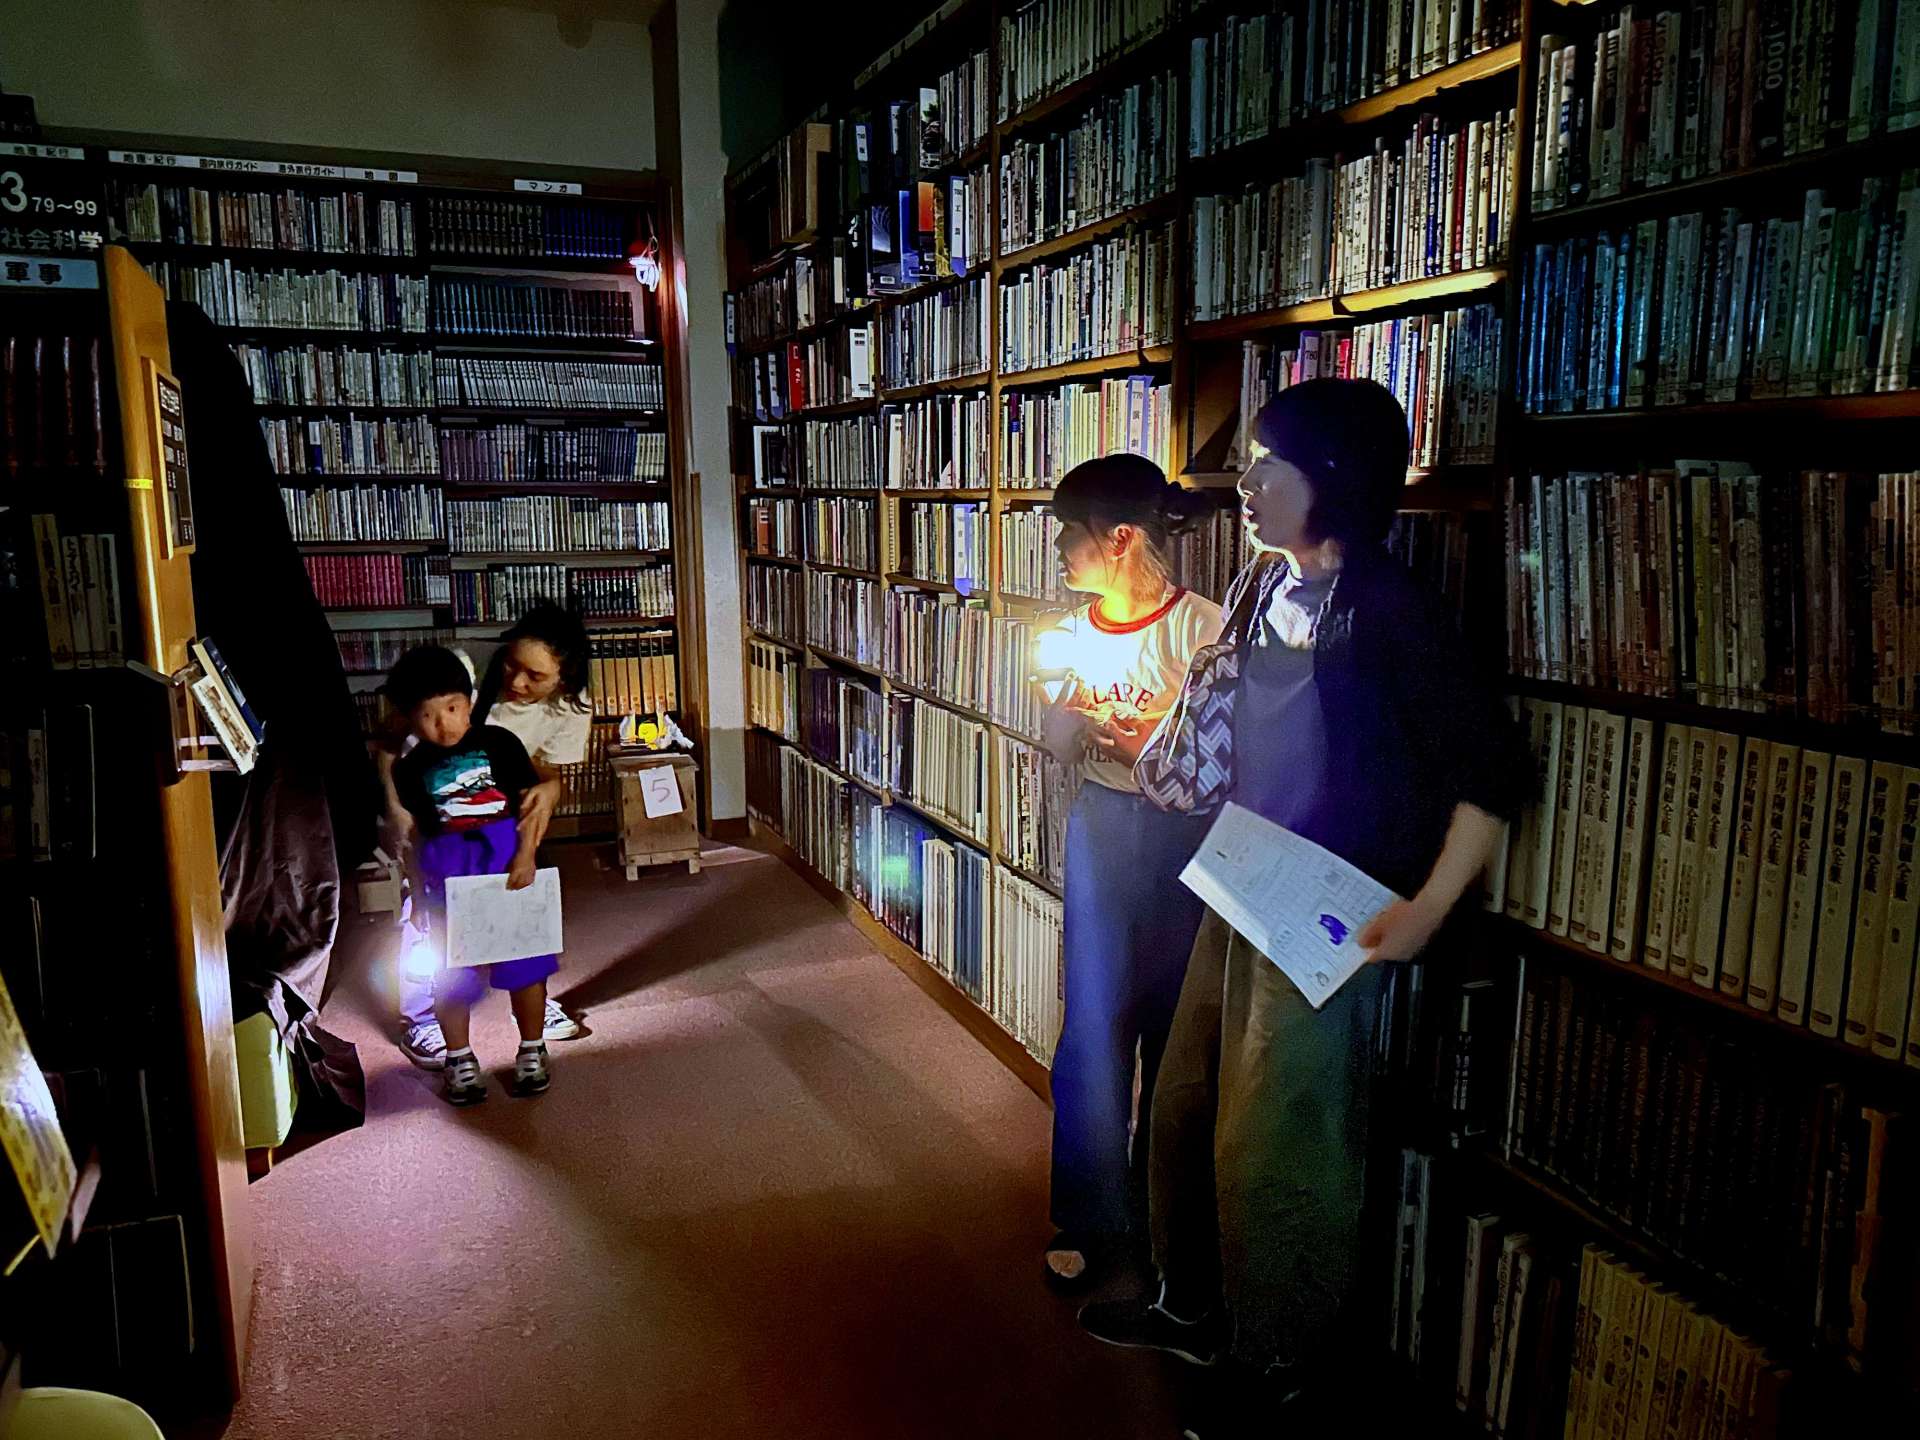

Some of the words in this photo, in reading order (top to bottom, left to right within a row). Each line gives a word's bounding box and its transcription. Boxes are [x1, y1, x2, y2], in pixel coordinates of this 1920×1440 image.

[0, 170, 28, 214] 3
[528, 181, 568, 193] マンガ
[0, 226, 103, 252] 社会科学
[5, 260, 62, 285] 軍事
[652, 777, 671, 803] 5
